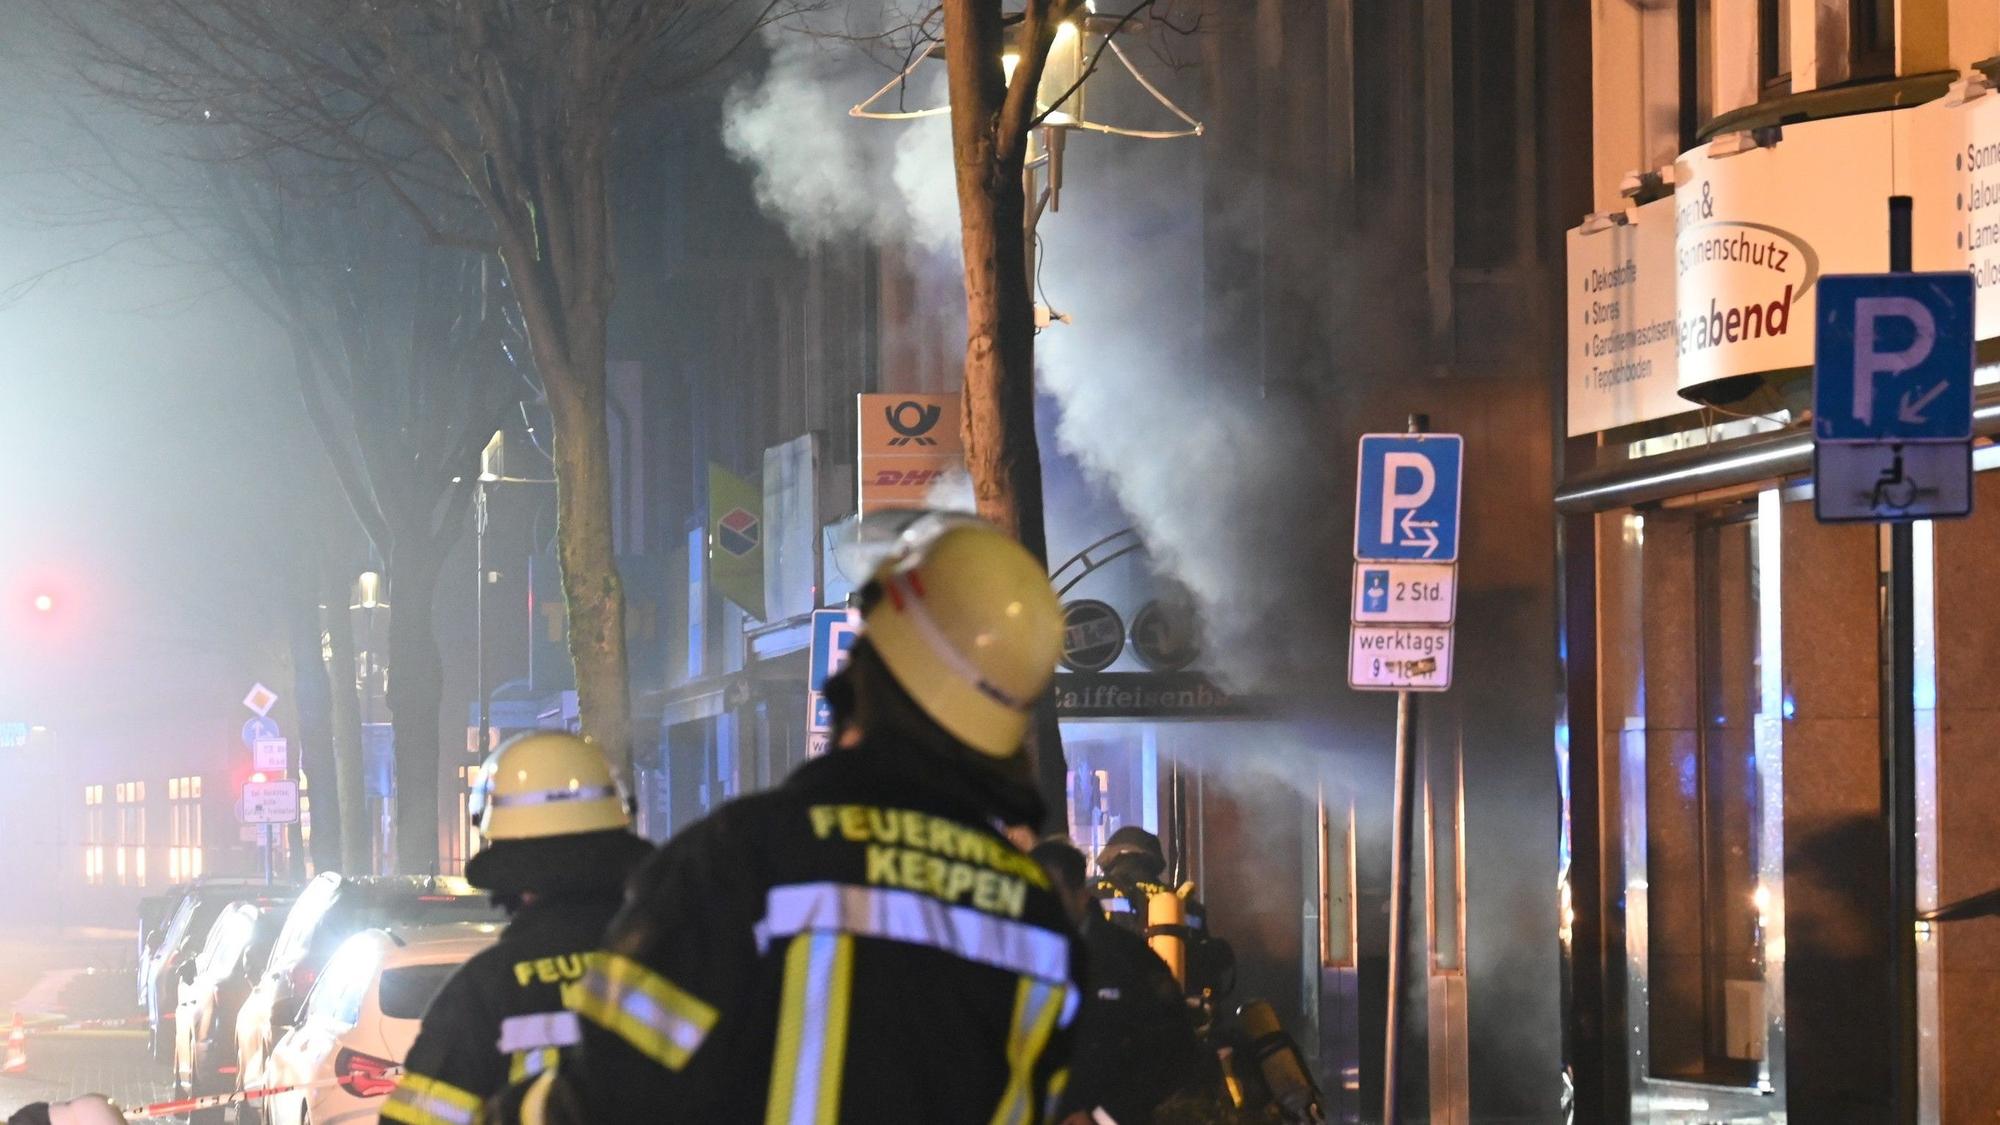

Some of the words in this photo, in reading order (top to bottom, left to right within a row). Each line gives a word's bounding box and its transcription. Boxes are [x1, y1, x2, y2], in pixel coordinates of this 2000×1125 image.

[1967, 180, 2000, 212] Jalou
[1968, 222, 2000, 251] Lame
[1679, 231, 1788, 276] Sonnenschutz
[1852, 297, 1936, 426] P
[874, 469, 945, 486] DH
[1380, 452, 1436, 544] P
[1396, 583, 1406, 601] 2
[1360, 630, 1445, 655] werktags
[1373, 658, 1380, 678] 9
[866, 842, 1027, 918] KERPEN
